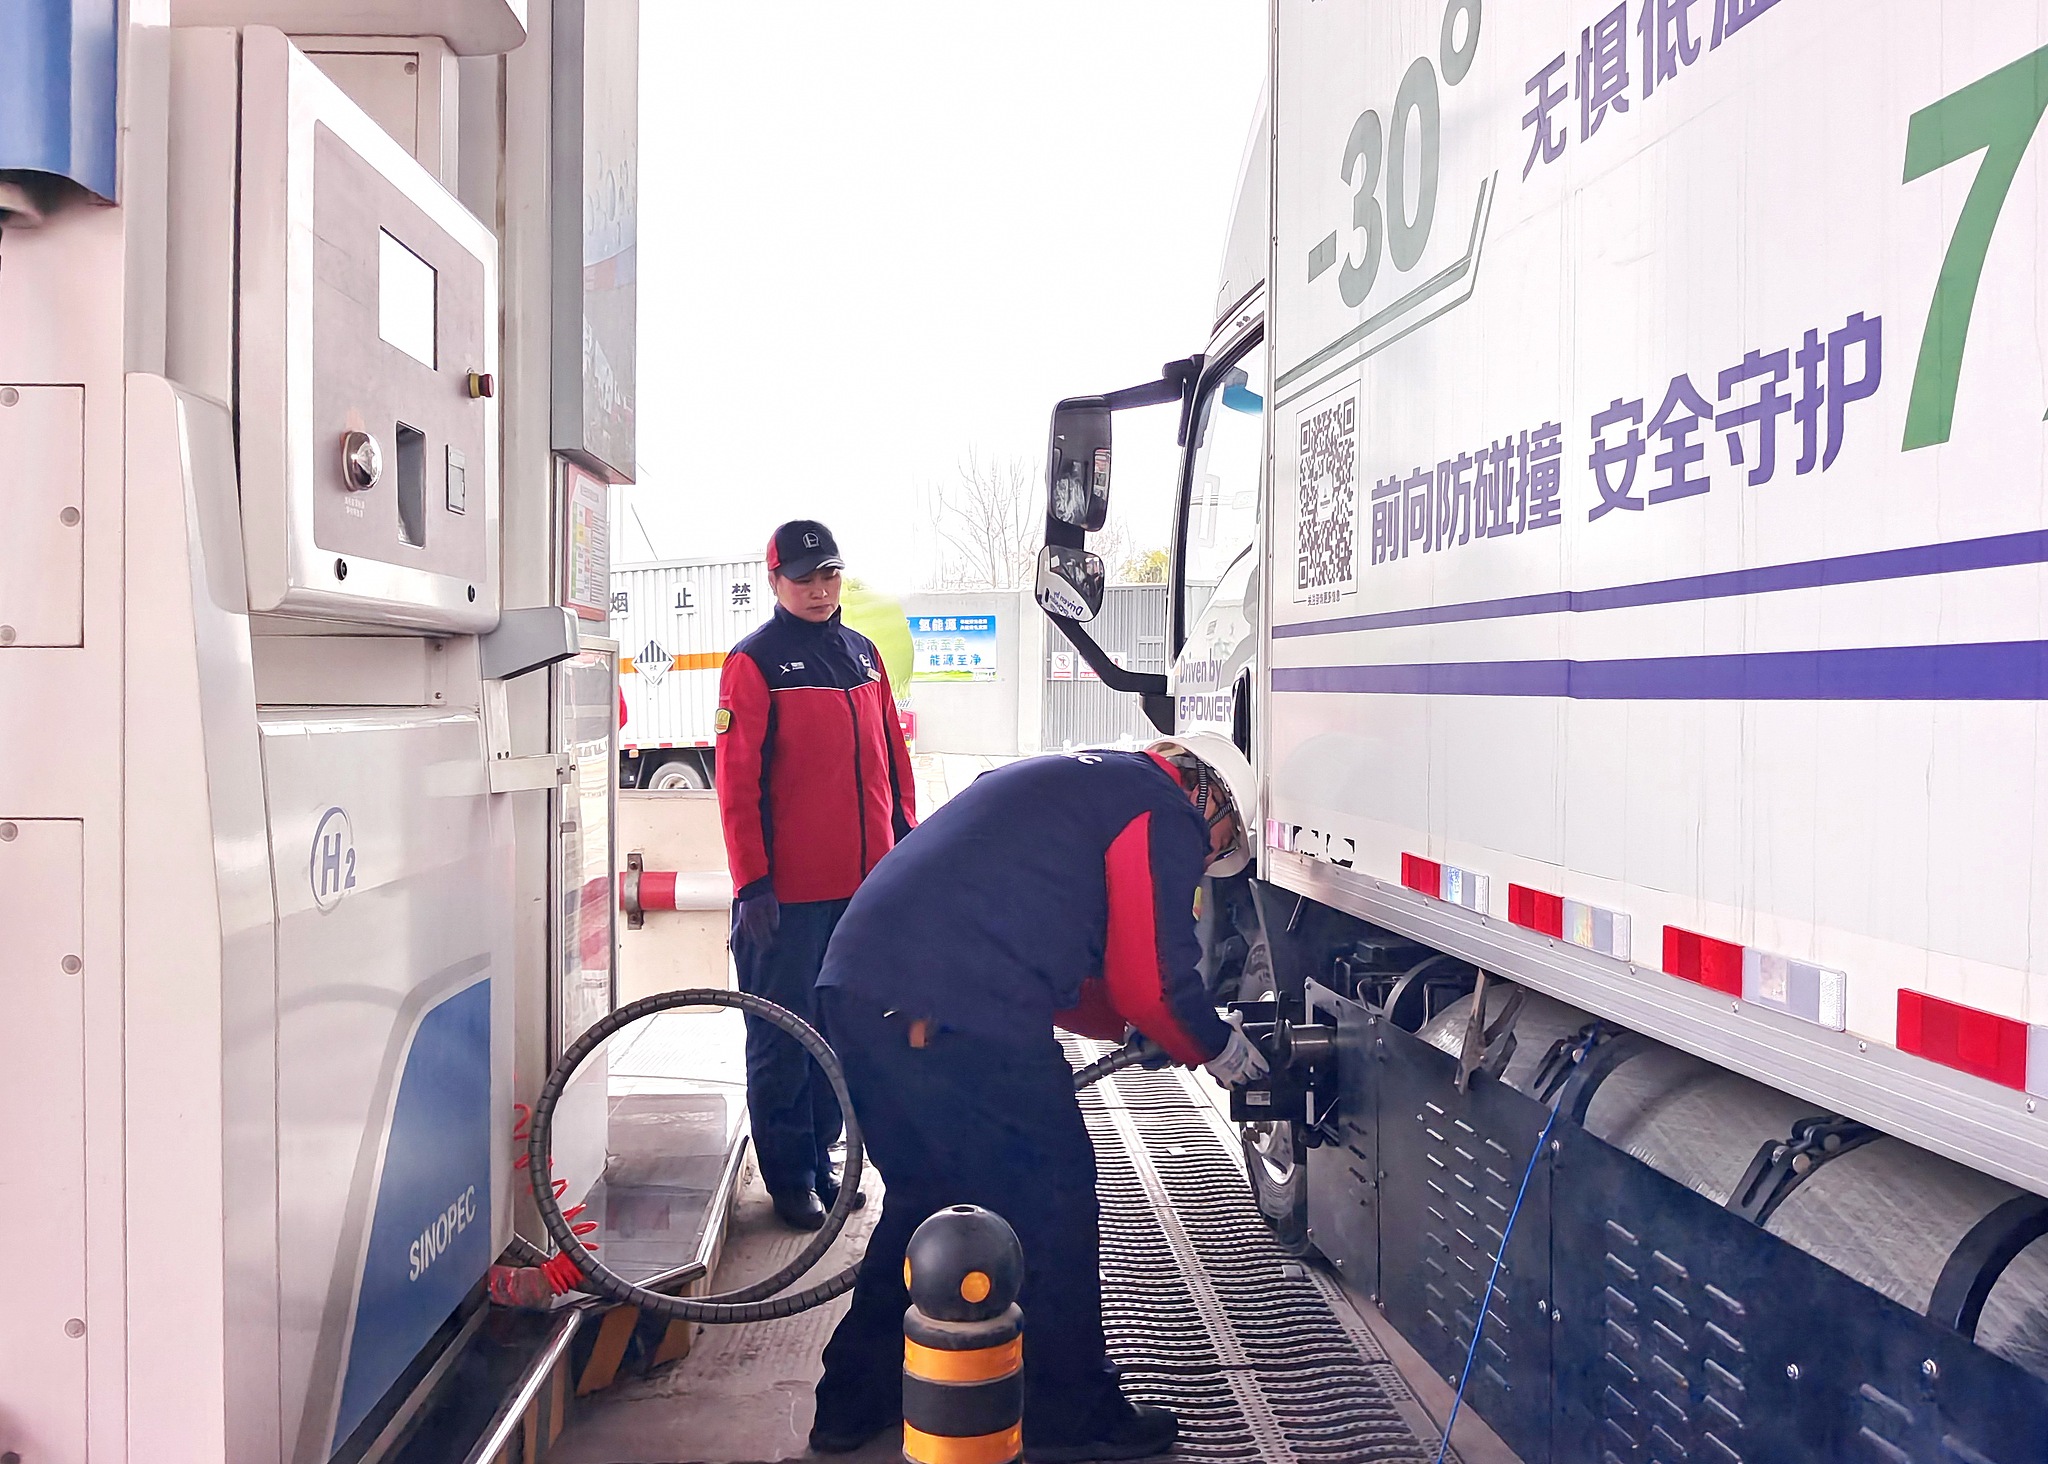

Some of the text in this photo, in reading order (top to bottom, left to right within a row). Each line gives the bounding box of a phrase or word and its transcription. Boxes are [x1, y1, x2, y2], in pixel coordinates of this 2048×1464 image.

[1371, 311, 1883, 566] 前向防碰撞 安全守护
[610, 583, 751, 613] 烟 止 禁
[929, 653, 982, 667] 能源至净
[1180, 647, 1222, 692] Driven by
[409, 1184, 477, 1282] SINOPEC
